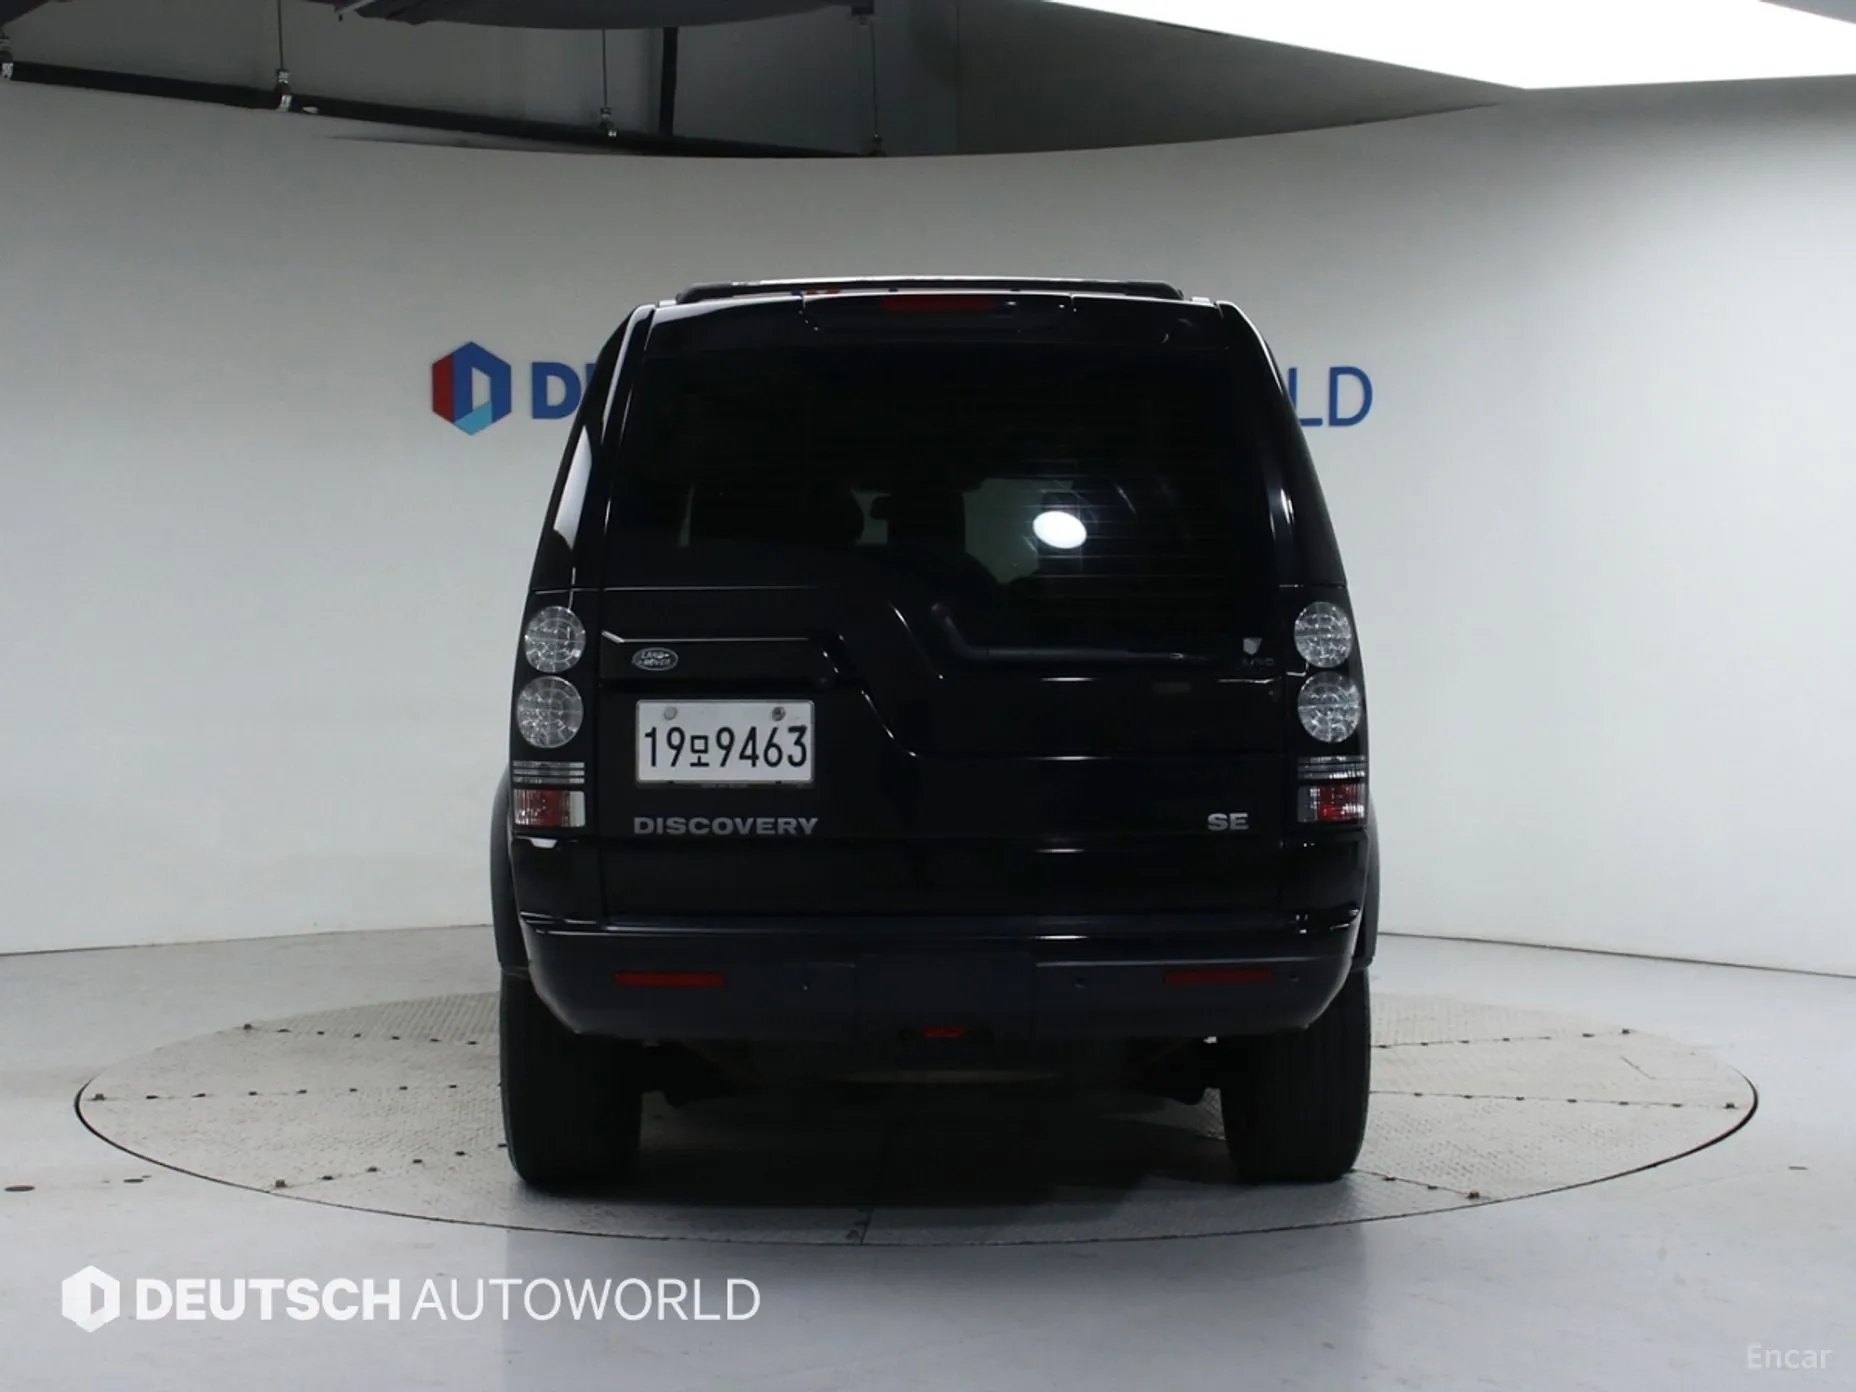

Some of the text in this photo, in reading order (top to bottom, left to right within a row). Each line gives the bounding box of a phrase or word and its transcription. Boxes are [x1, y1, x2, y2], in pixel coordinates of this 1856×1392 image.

[644, 725, 808, 768] 19모9463
[633, 816, 819, 835] DISCOVERY
[1207, 812, 1249, 831] SE
